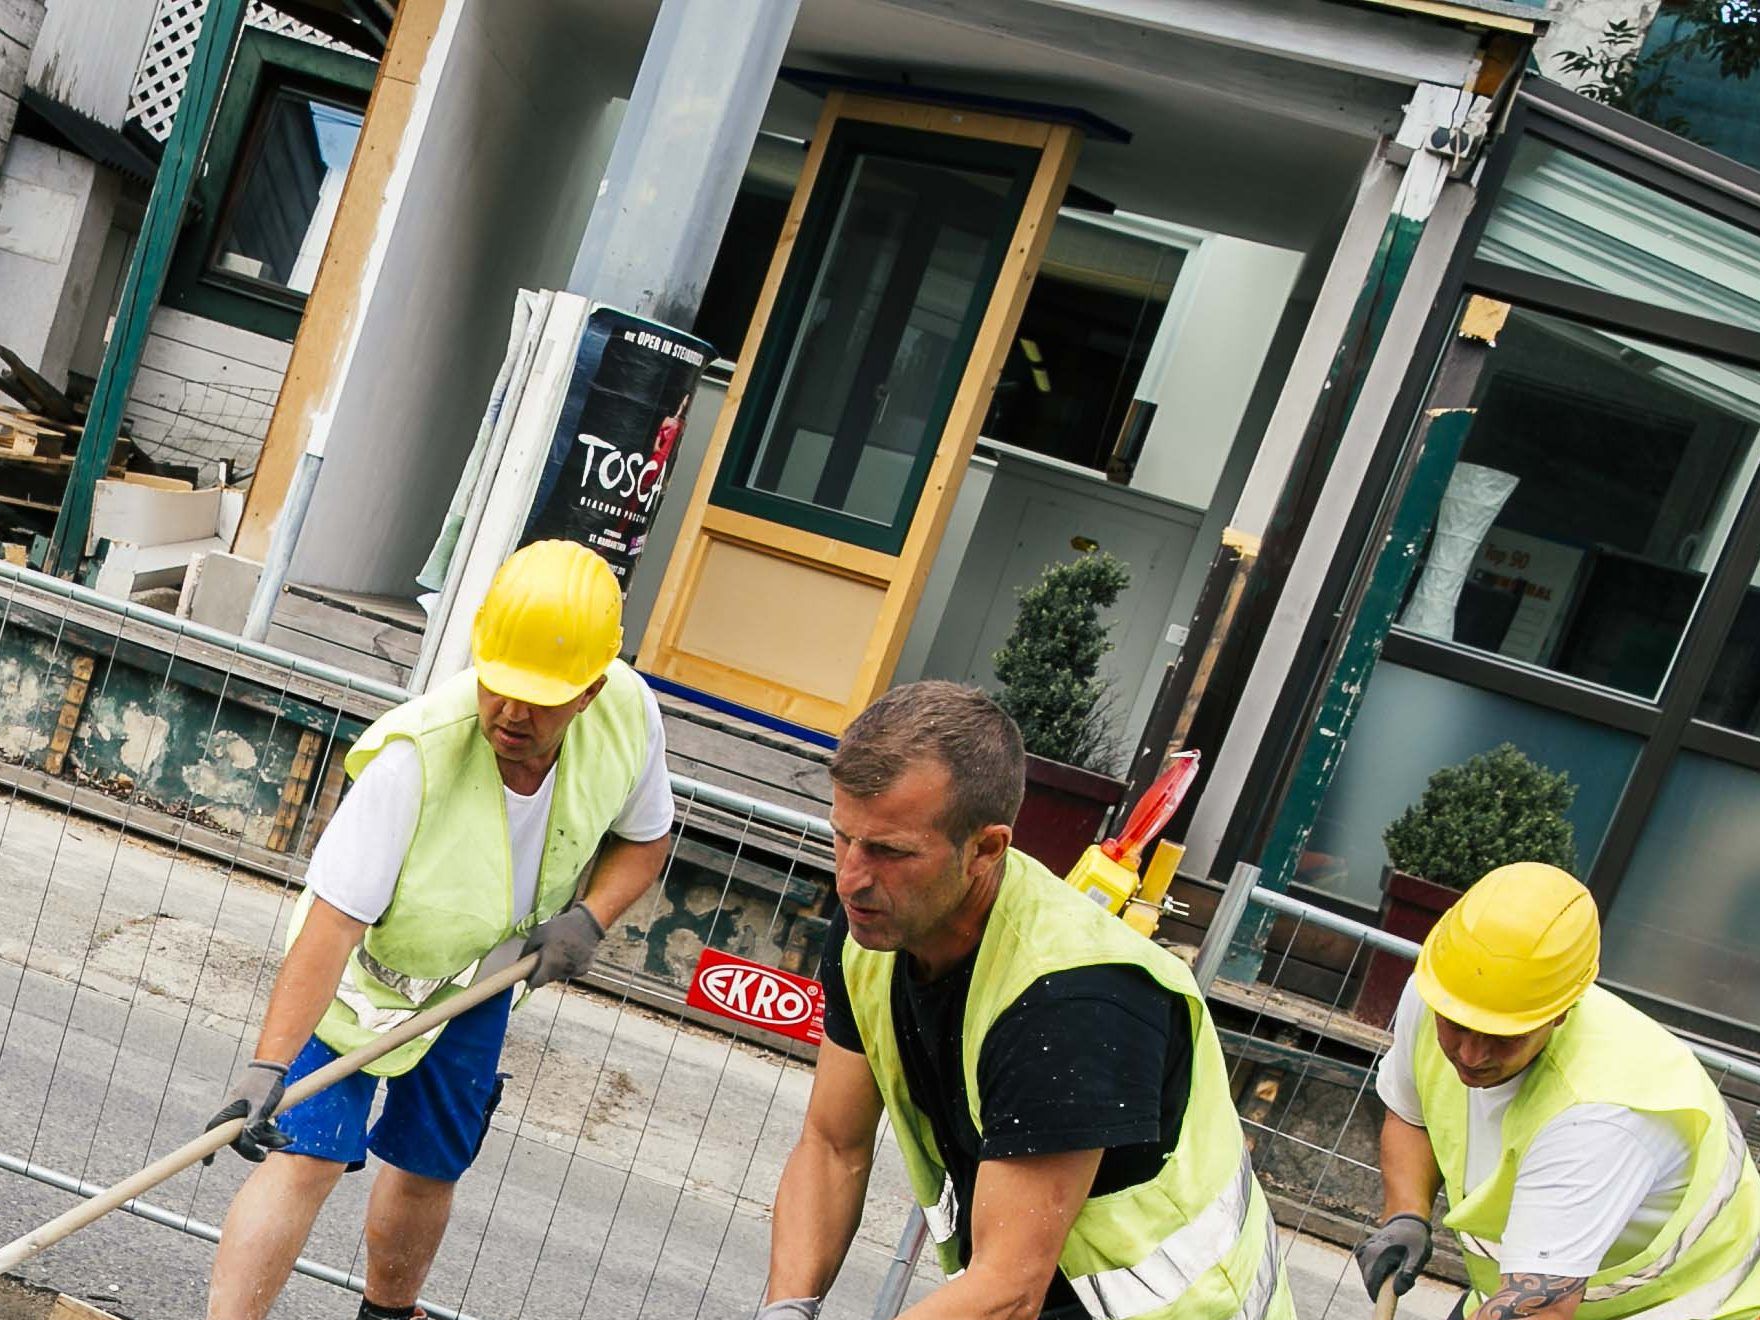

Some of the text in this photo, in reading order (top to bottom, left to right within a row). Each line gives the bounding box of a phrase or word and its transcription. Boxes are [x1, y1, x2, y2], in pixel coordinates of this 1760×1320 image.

[637, 331, 661, 351] OPER
[578, 433, 667, 513] TOSCA
[706, 969, 804, 1019] EKRO
